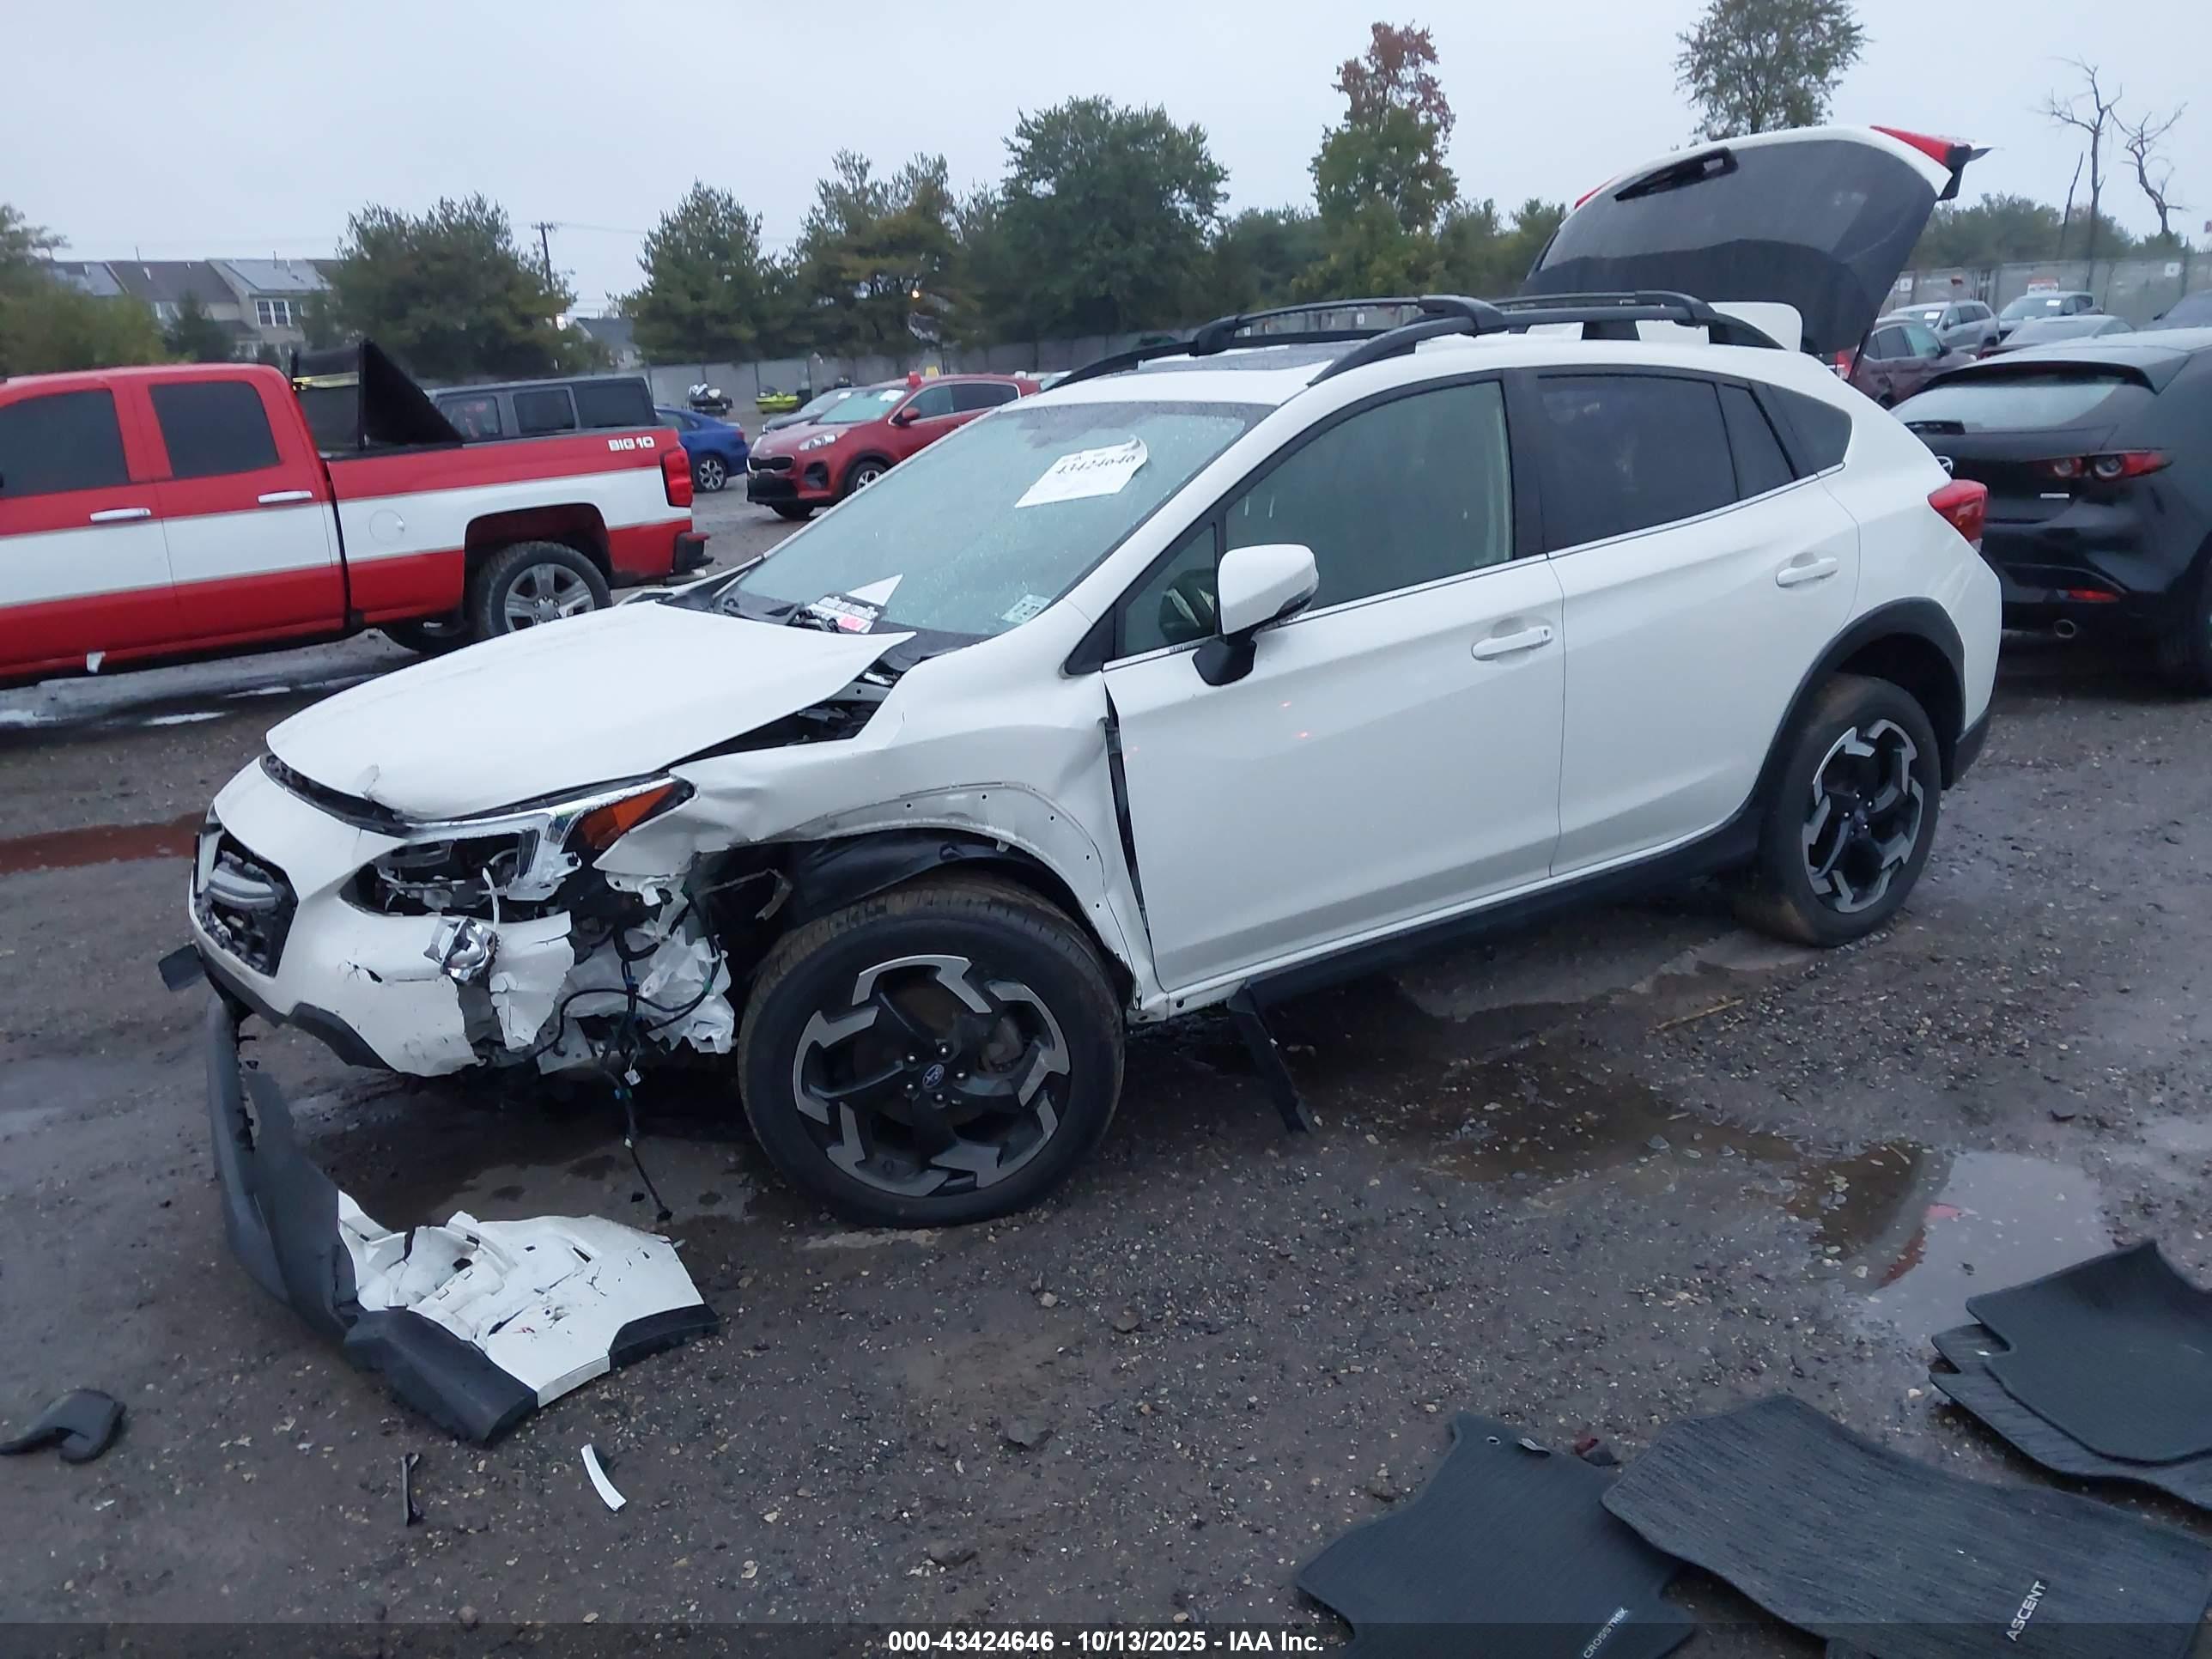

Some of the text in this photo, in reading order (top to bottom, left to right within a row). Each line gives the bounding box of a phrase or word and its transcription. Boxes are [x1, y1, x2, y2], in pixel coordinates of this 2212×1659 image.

[635, 435, 655, 448] 10
[1583, 1607, 1629, 1658] CROSSTREK
[2006, 1580, 2046, 1641] ASCENT
